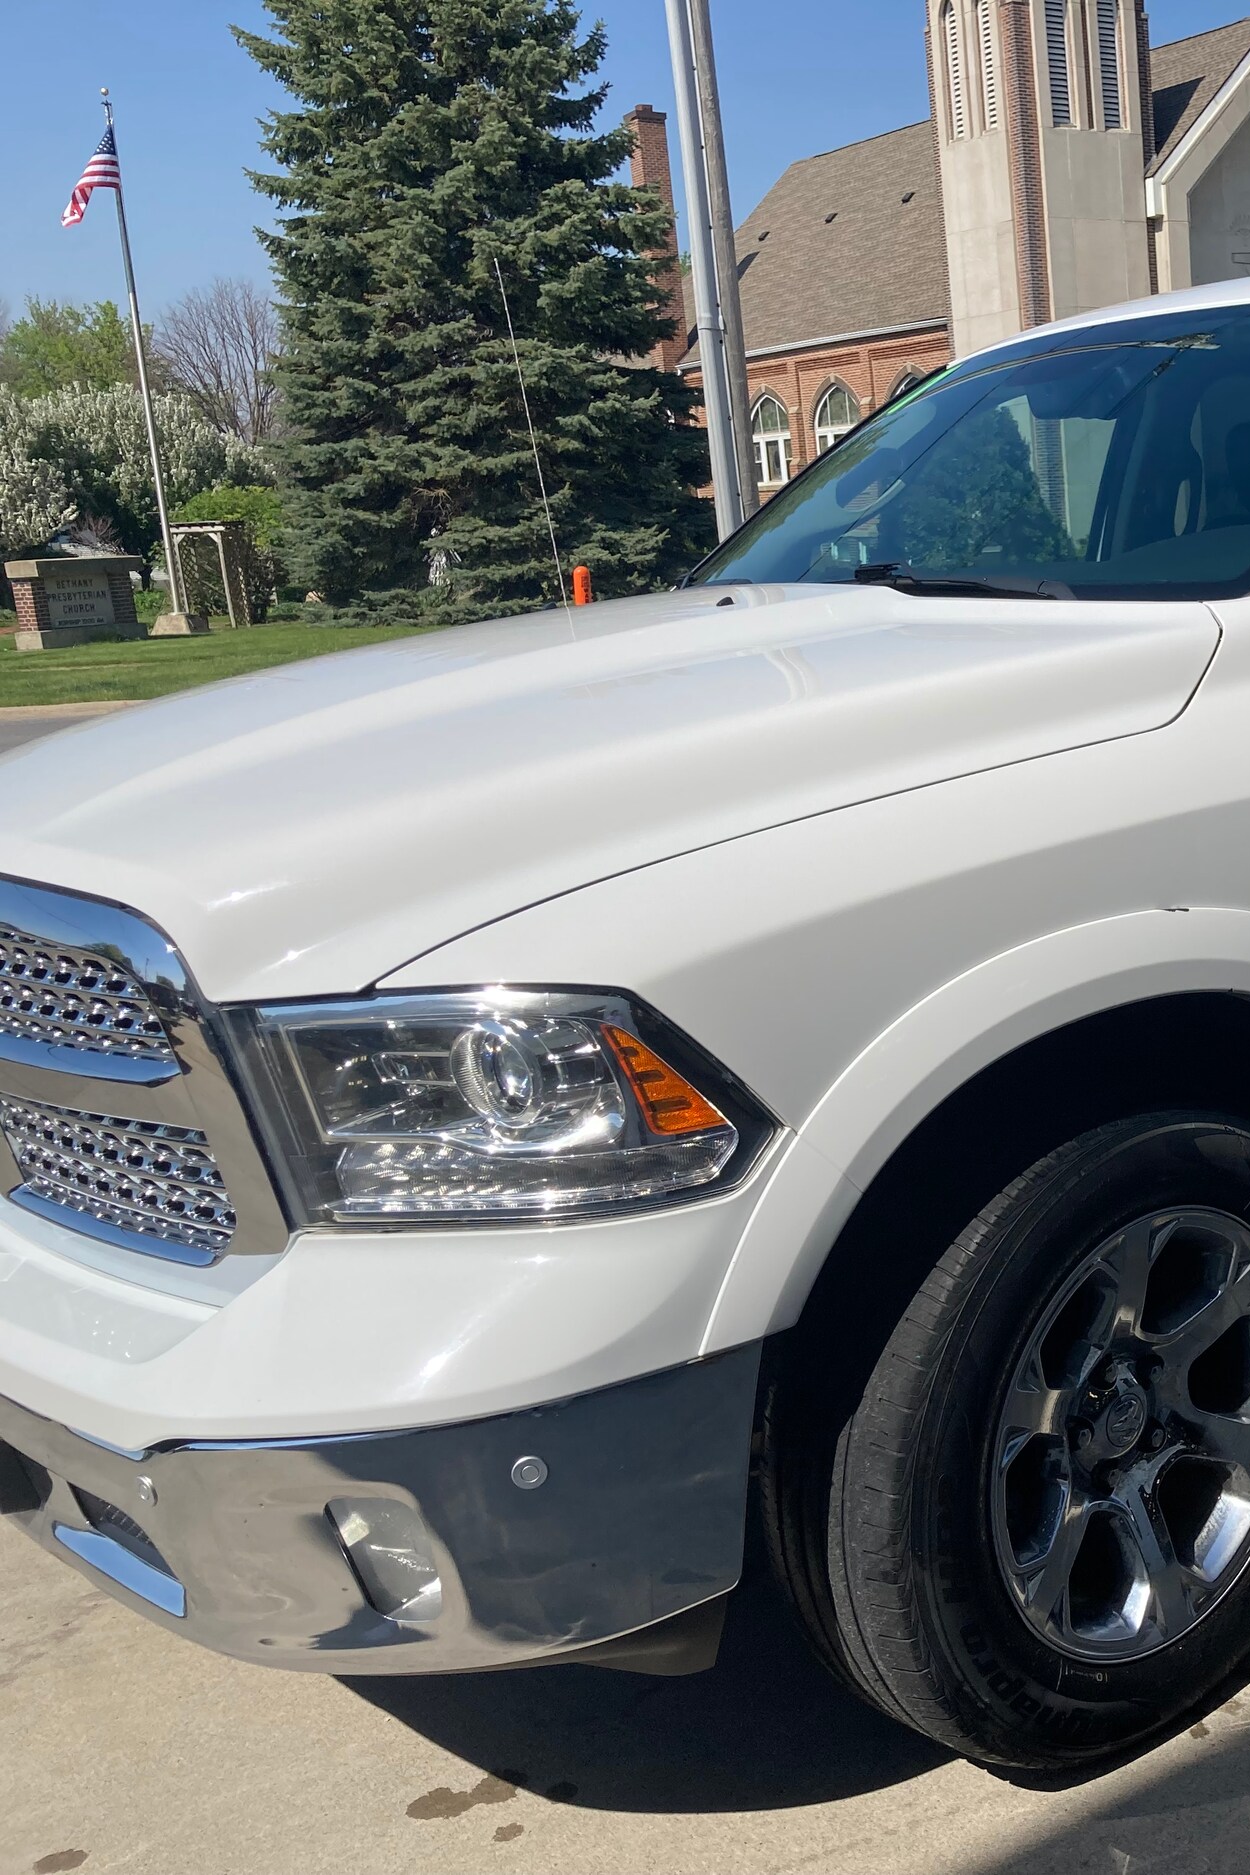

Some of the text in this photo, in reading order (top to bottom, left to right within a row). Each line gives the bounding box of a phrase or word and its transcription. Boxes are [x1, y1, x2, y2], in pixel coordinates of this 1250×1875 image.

[56, 579, 93, 589] BETHANY
[47, 590, 107, 601] PRESBYTERIAN
[63, 603, 95, 614] CHURCH
